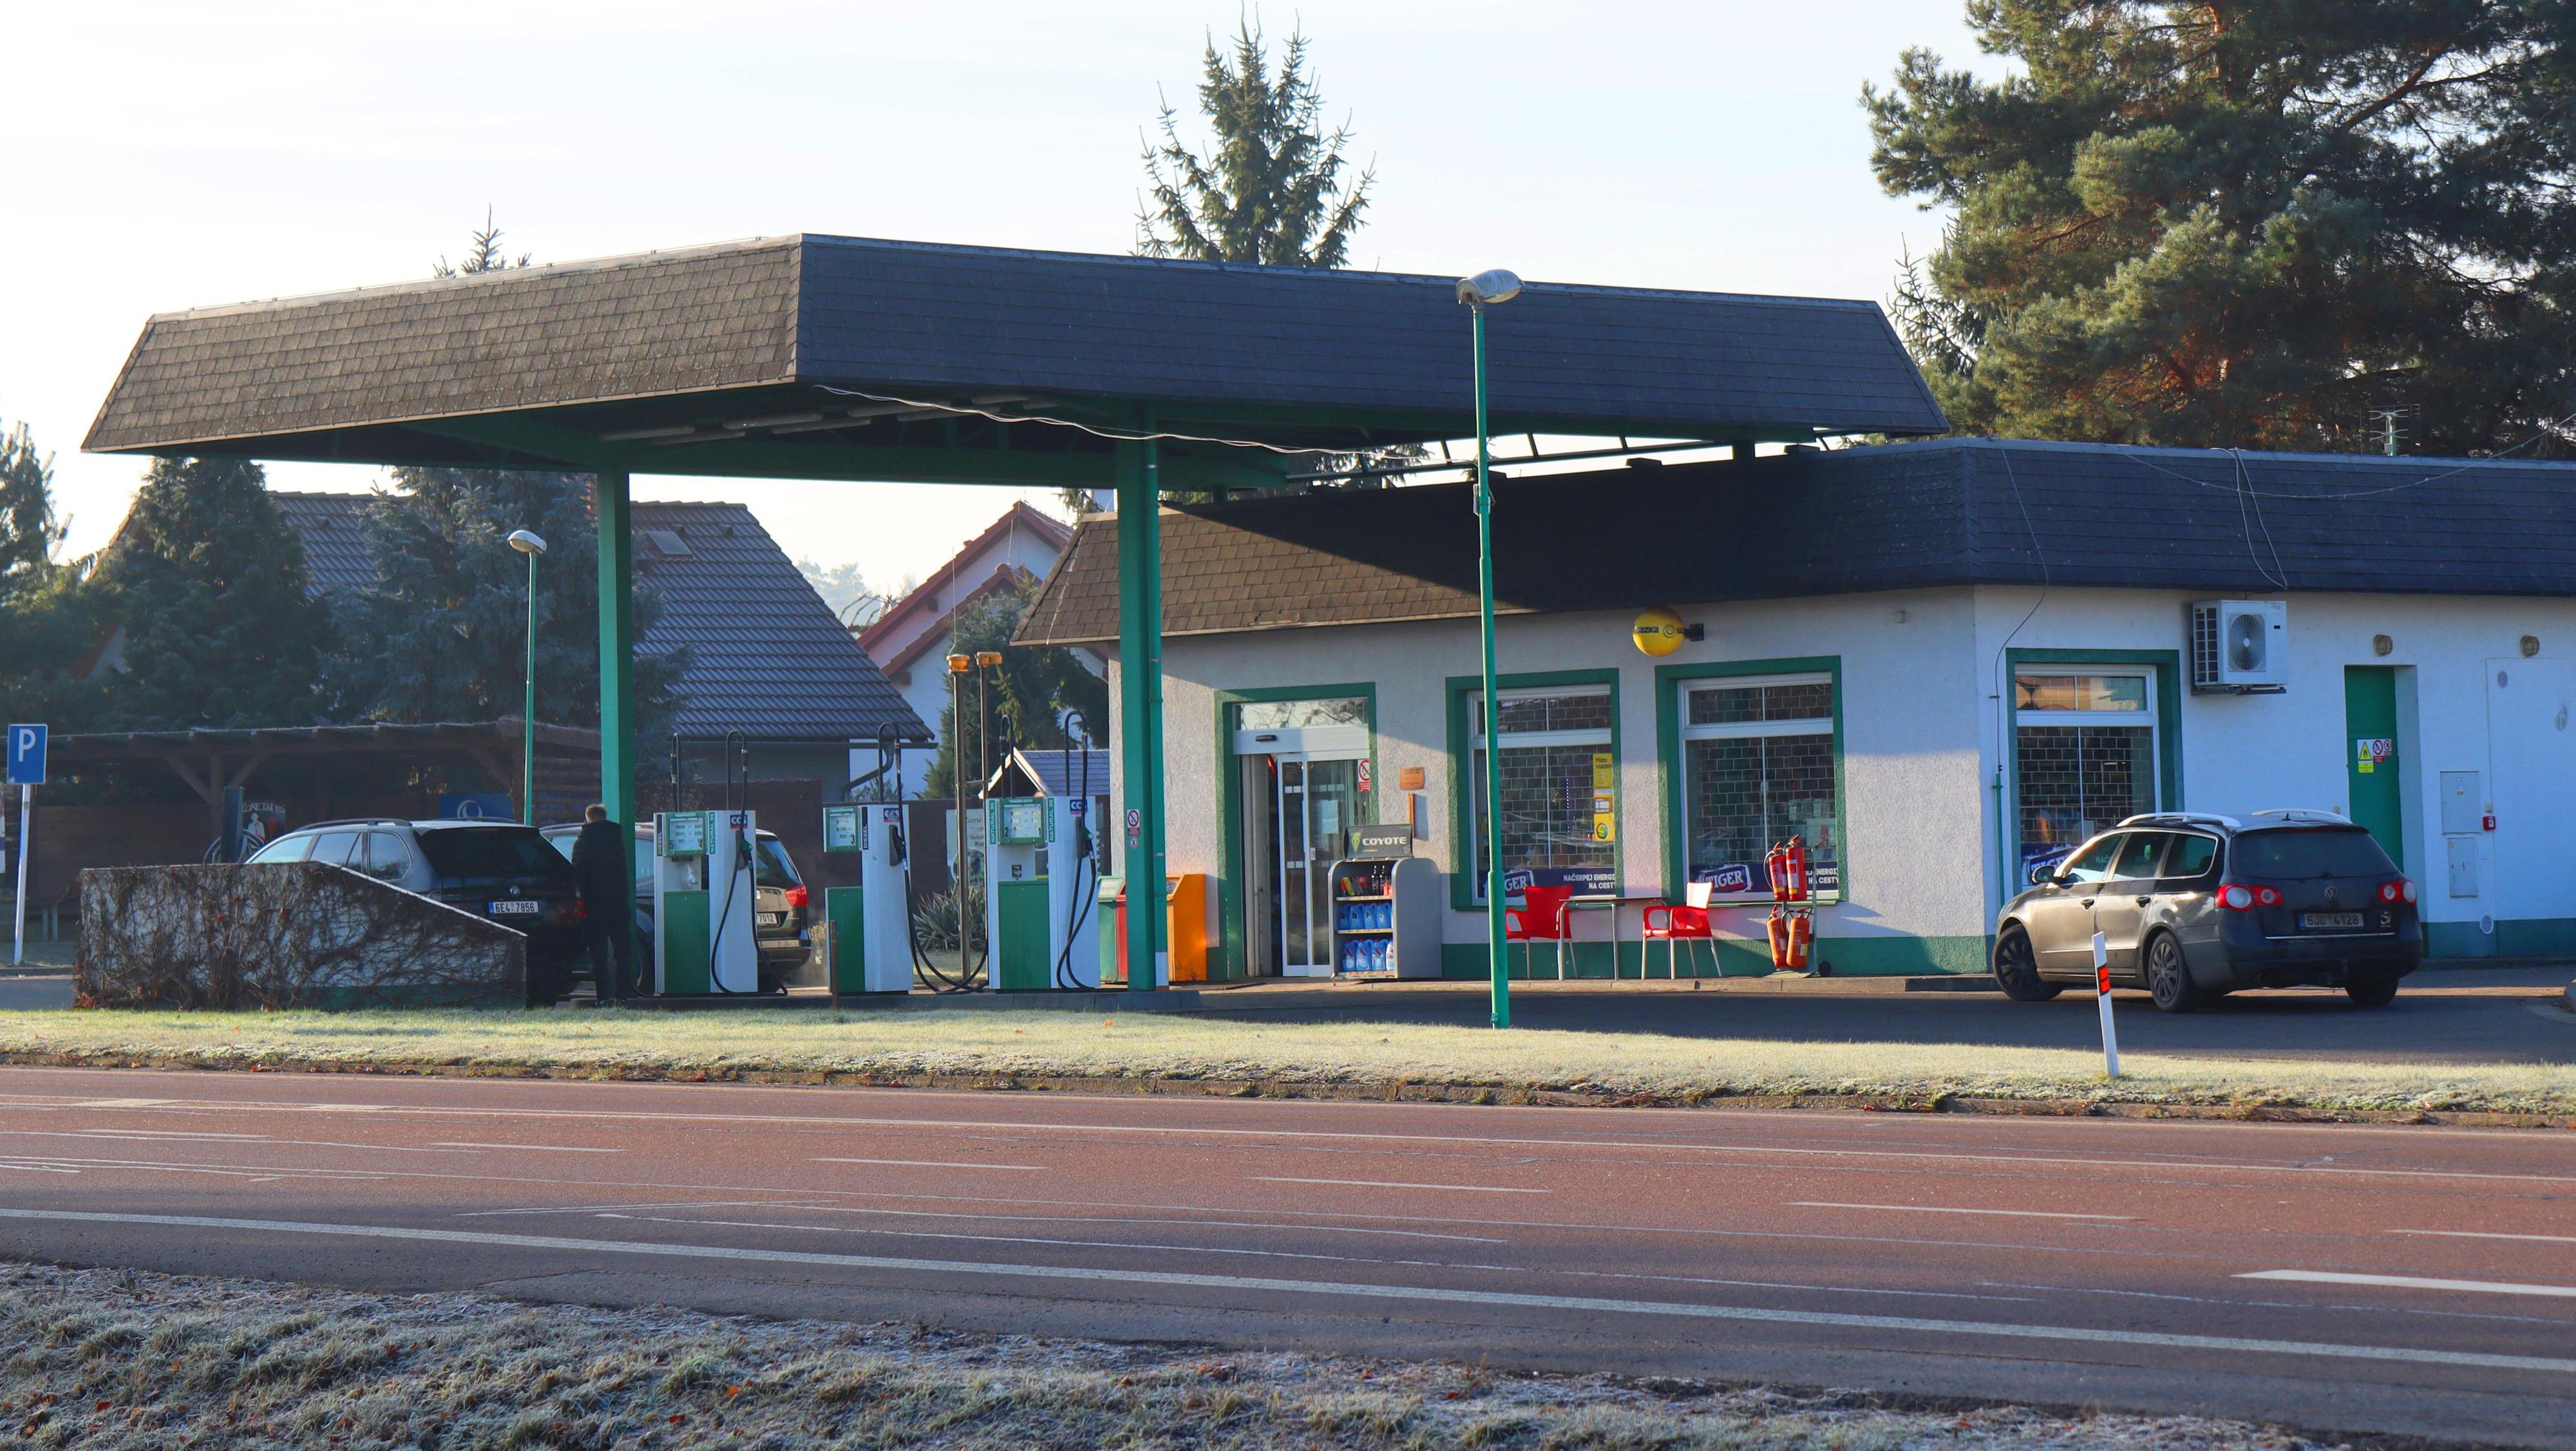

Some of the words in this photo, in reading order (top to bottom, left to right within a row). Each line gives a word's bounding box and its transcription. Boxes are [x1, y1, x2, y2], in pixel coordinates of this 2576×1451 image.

[18, 728, 36, 763] P
[1071, 801, 1086, 810] CC
[1362, 837, 1407, 846] COYOTE
[1504, 875, 1526, 891] GER
[495, 903, 510, 913] 6E4
[515, 903, 535, 912] 7856
